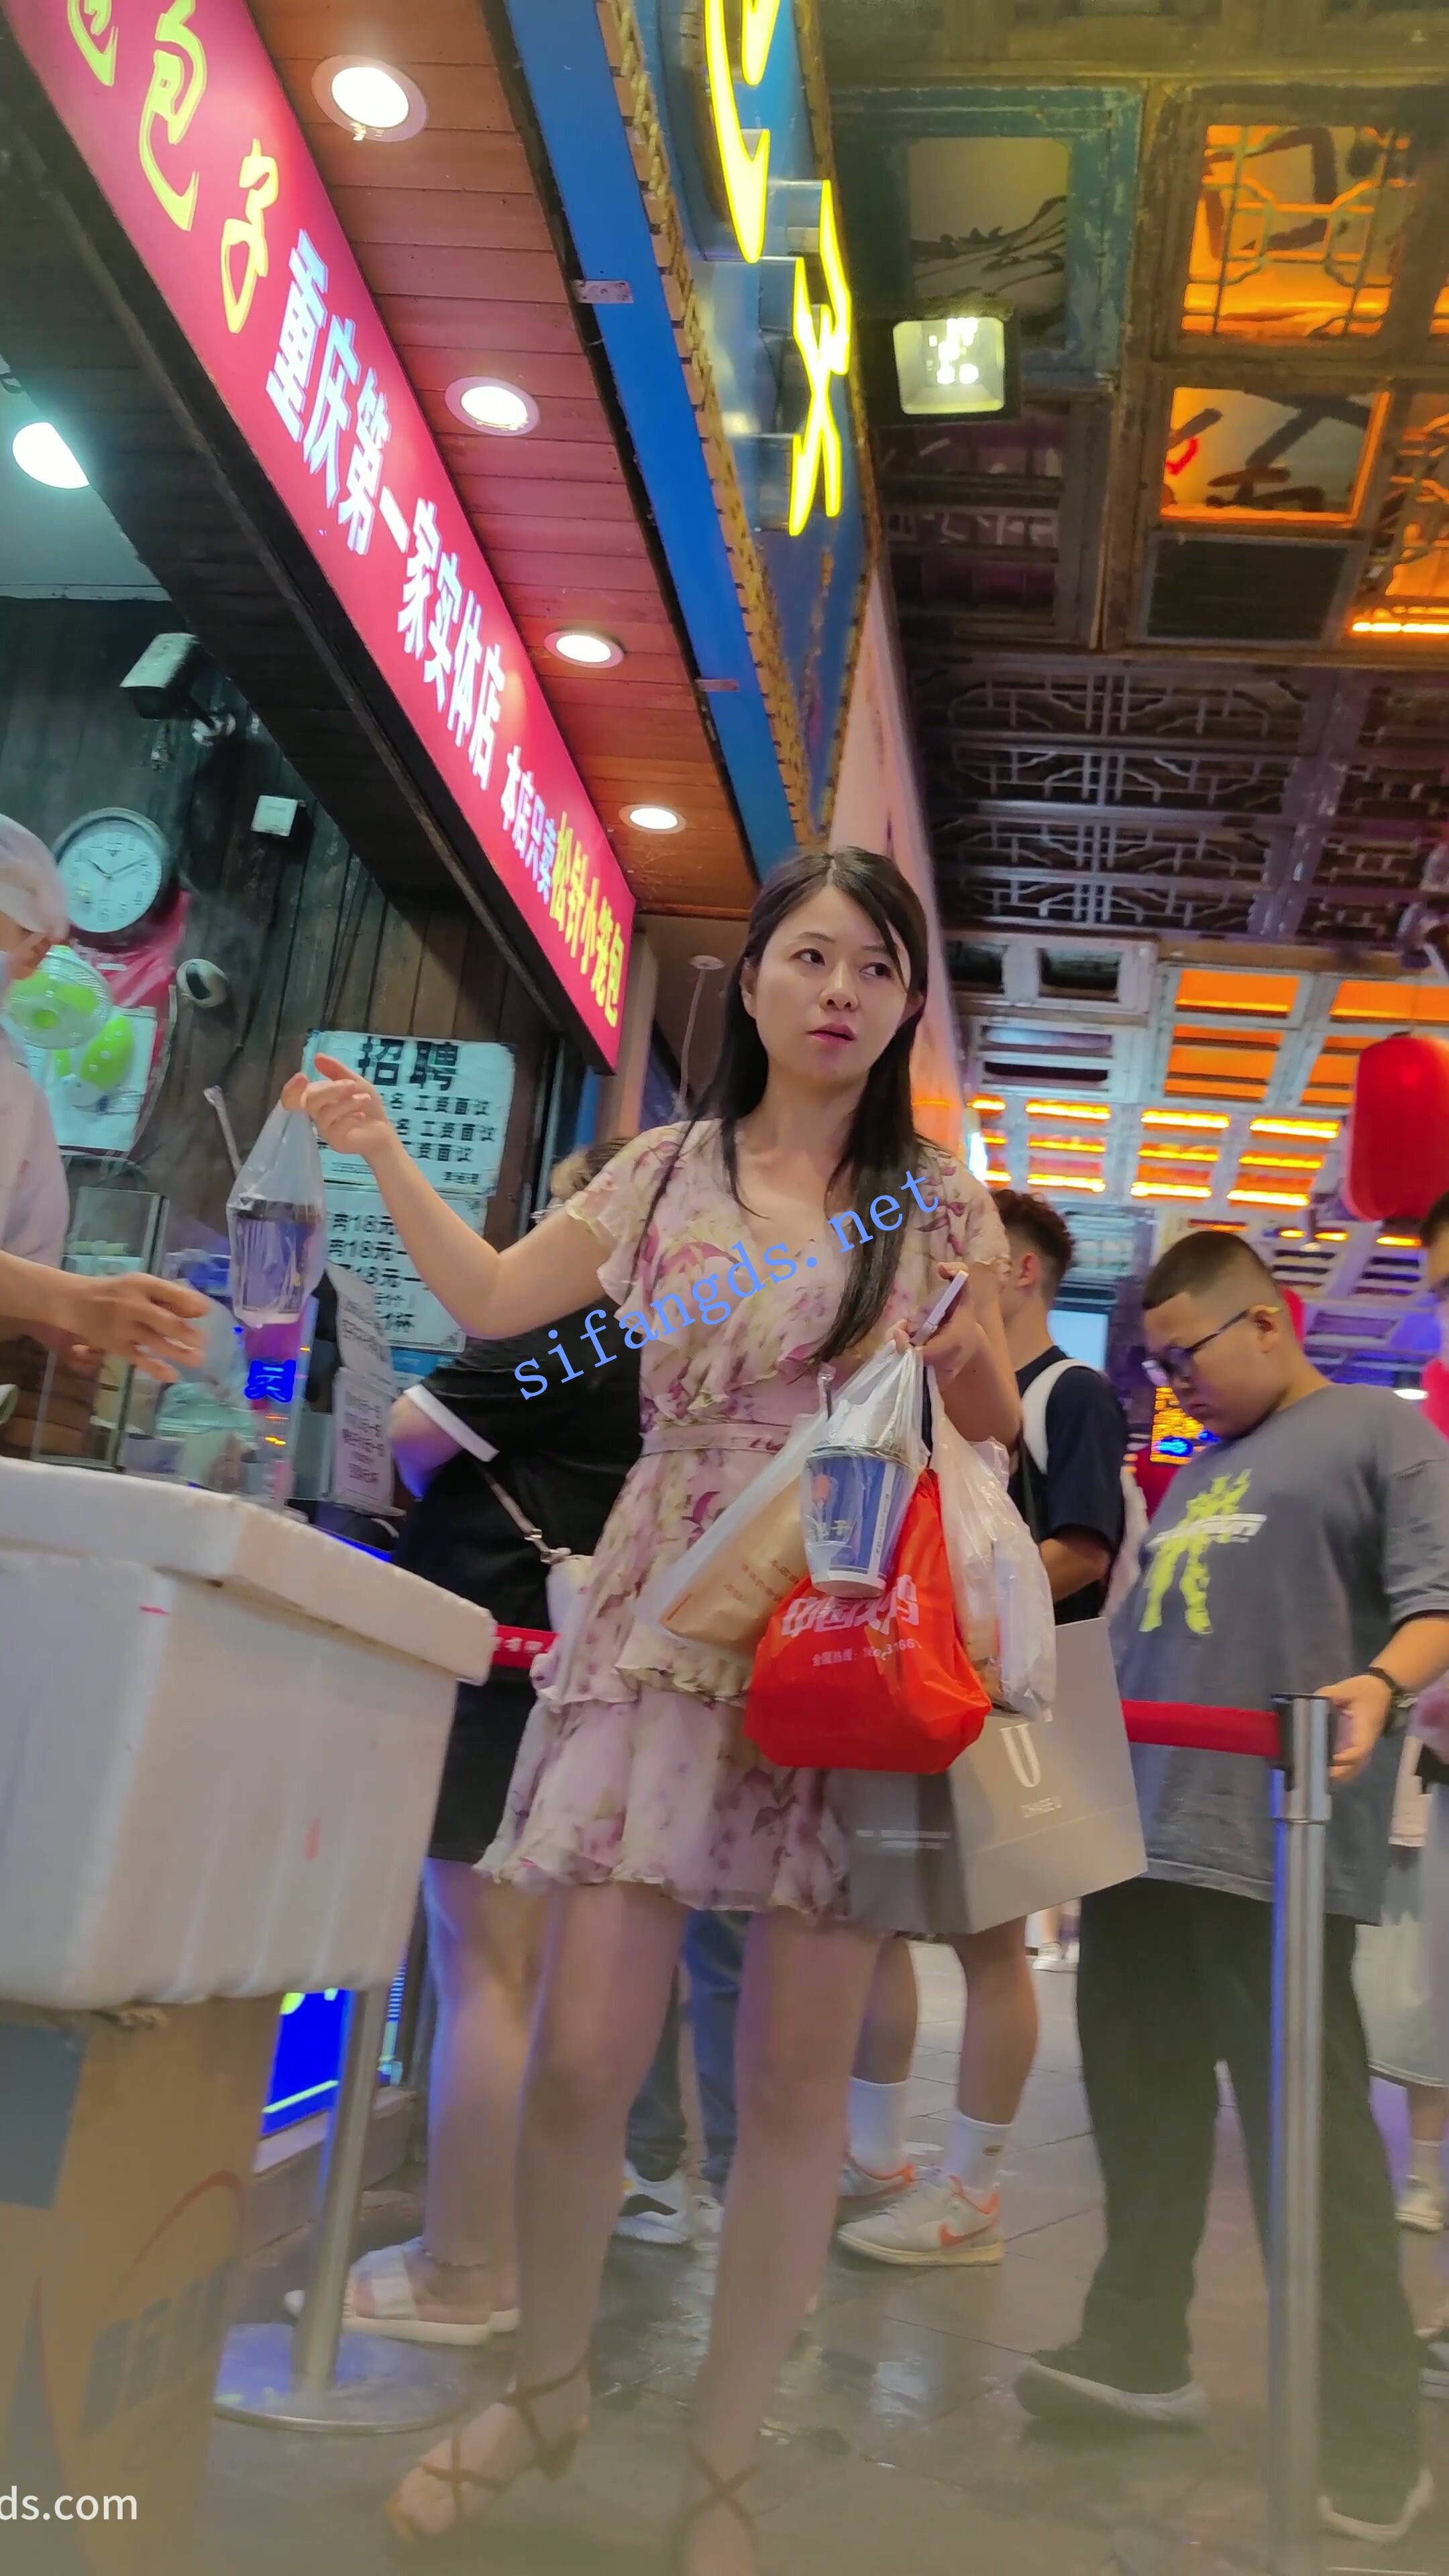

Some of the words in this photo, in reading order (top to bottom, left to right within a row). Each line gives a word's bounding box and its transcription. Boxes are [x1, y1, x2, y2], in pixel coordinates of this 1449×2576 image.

[266, 228, 506, 791] 重庆第一家实体店
[358, 1036, 459, 1091] 招聘
